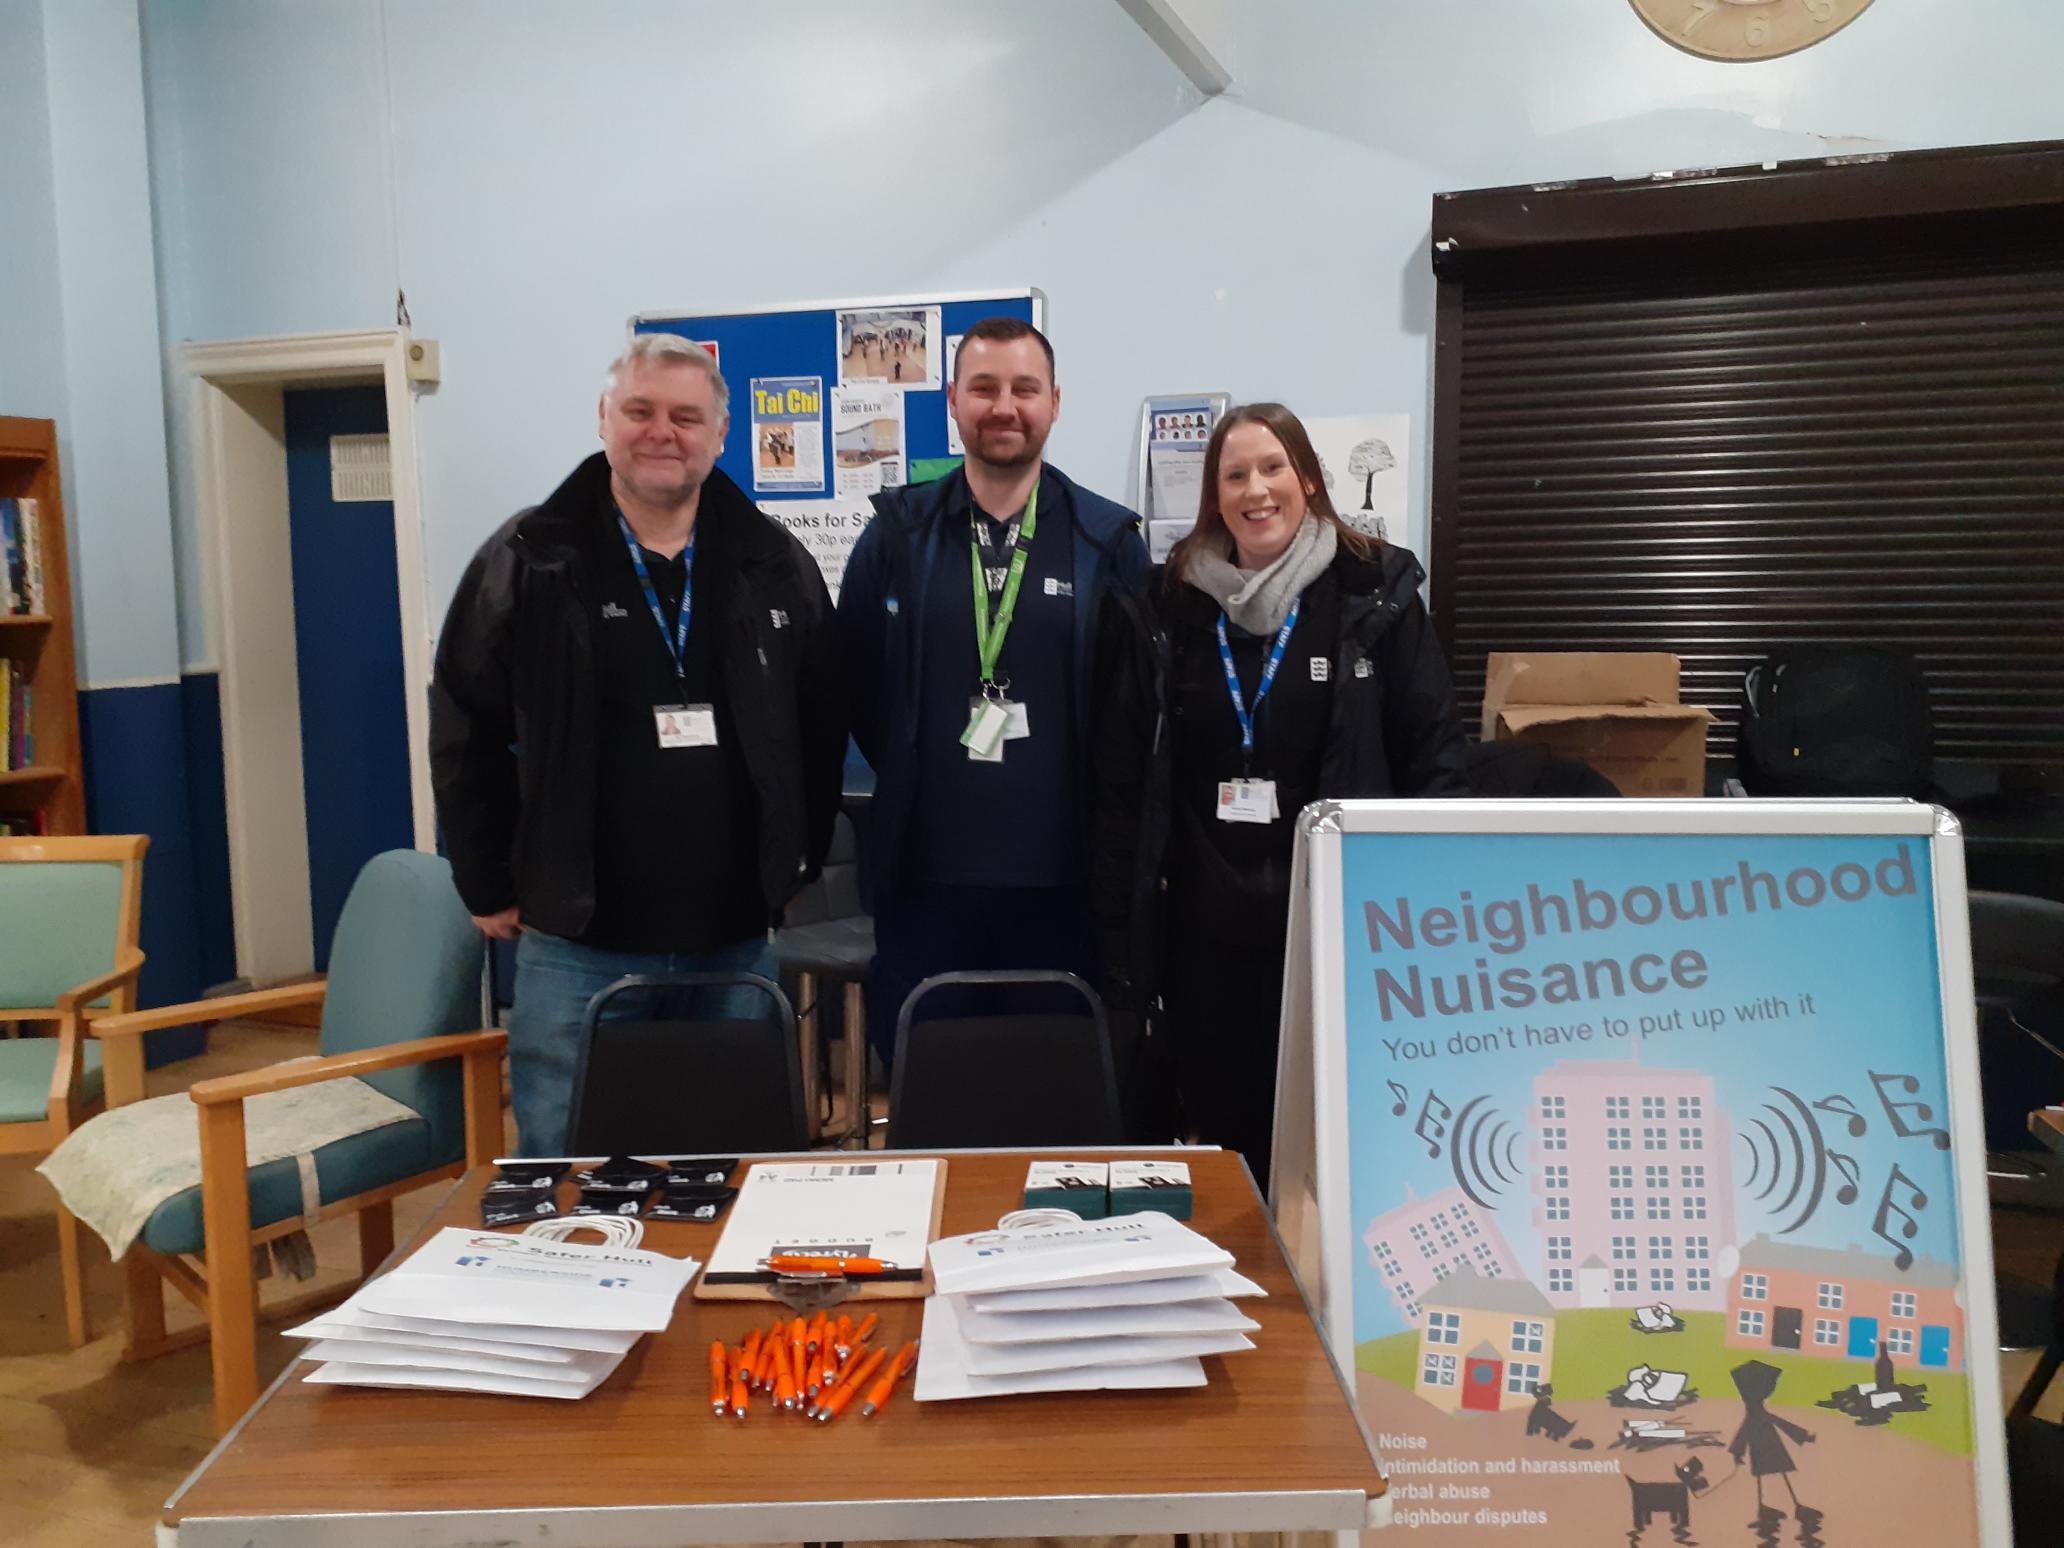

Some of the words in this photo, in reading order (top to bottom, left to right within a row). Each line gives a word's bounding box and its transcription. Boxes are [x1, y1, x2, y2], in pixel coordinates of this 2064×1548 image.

[1743, 16, 1768, 47] 6
[755, 390, 784, 415] Tai
[786, 388, 819, 414] Chi
[840, 404, 862, 415] SOUND
[863, 402, 882, 413] BATH
[824, 512, 848, 528] for
[814, 532, 838, 548] 30p
[1363, 843, 1918, 955] Neighbourhood
[1374, 949, 1709, 1023] Nuisance
[1381, 1037, 1436, 1062] You
[1447, 1025, 1517, 1056] don't
[1525, 1022, 1594, 1047] have
[1602, 1015, 1630, 1038] to
[1639, 1007, 1684, 1041] put
[1692, 1005, 1726, 1033] up
[1734, 995, 1790, 1023] with
[1798, 992, 1817, 1016] it
[529, 1246, 596, 1261] Safer
[602, 1253, 653, 1266] Hull
[1379, 1433, 1428, 1449] Noise
[1485, 1457, 1516, 1474] and
[1521, 1457, 1621, 1474] harassment
[1439, 1483, 1491, 1499] abuse
[1393, 1509, 1469, 1528] eighbour
[1475, 1508, 1548, 1528] disputes
